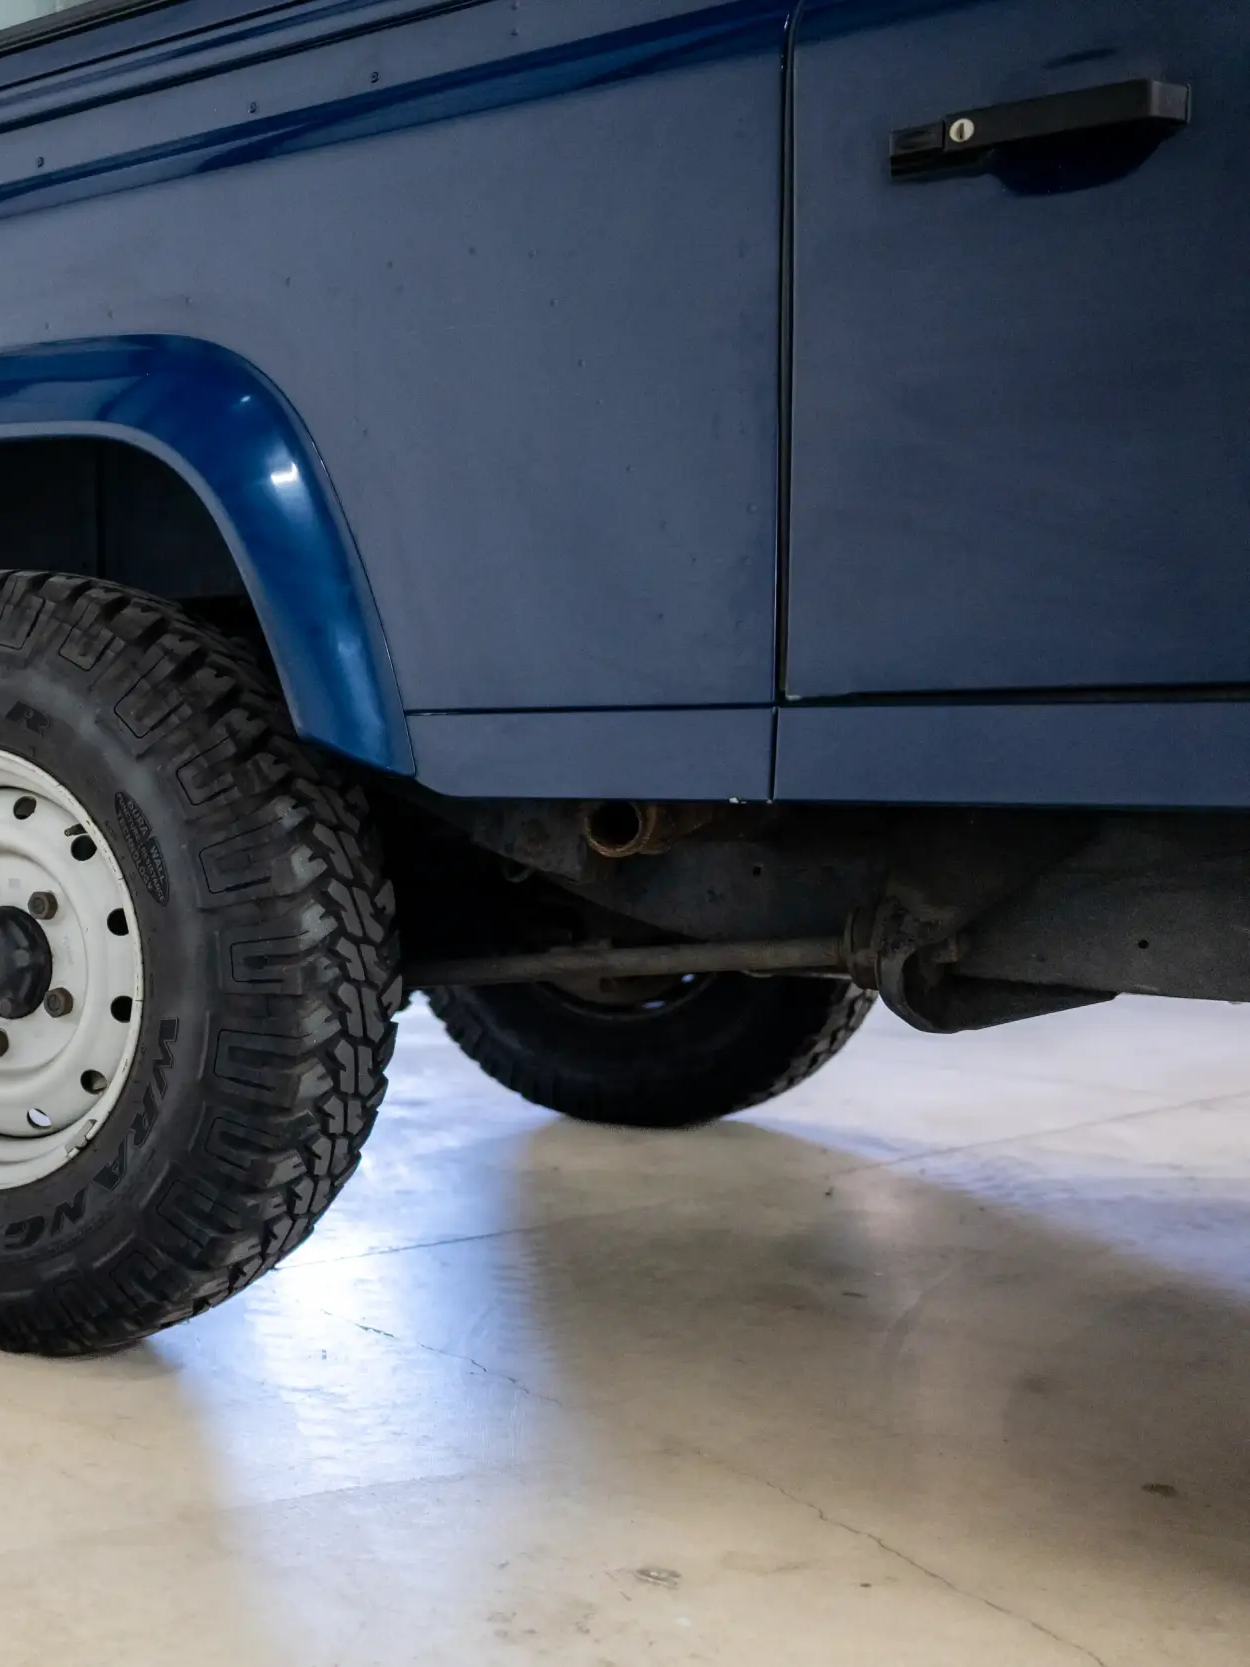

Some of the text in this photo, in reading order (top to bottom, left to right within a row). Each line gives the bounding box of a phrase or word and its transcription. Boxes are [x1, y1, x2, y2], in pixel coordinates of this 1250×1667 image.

[117, 812, 153, 890] TECHNOLOGY
[126, 799, 165, 884] DURA WALL
